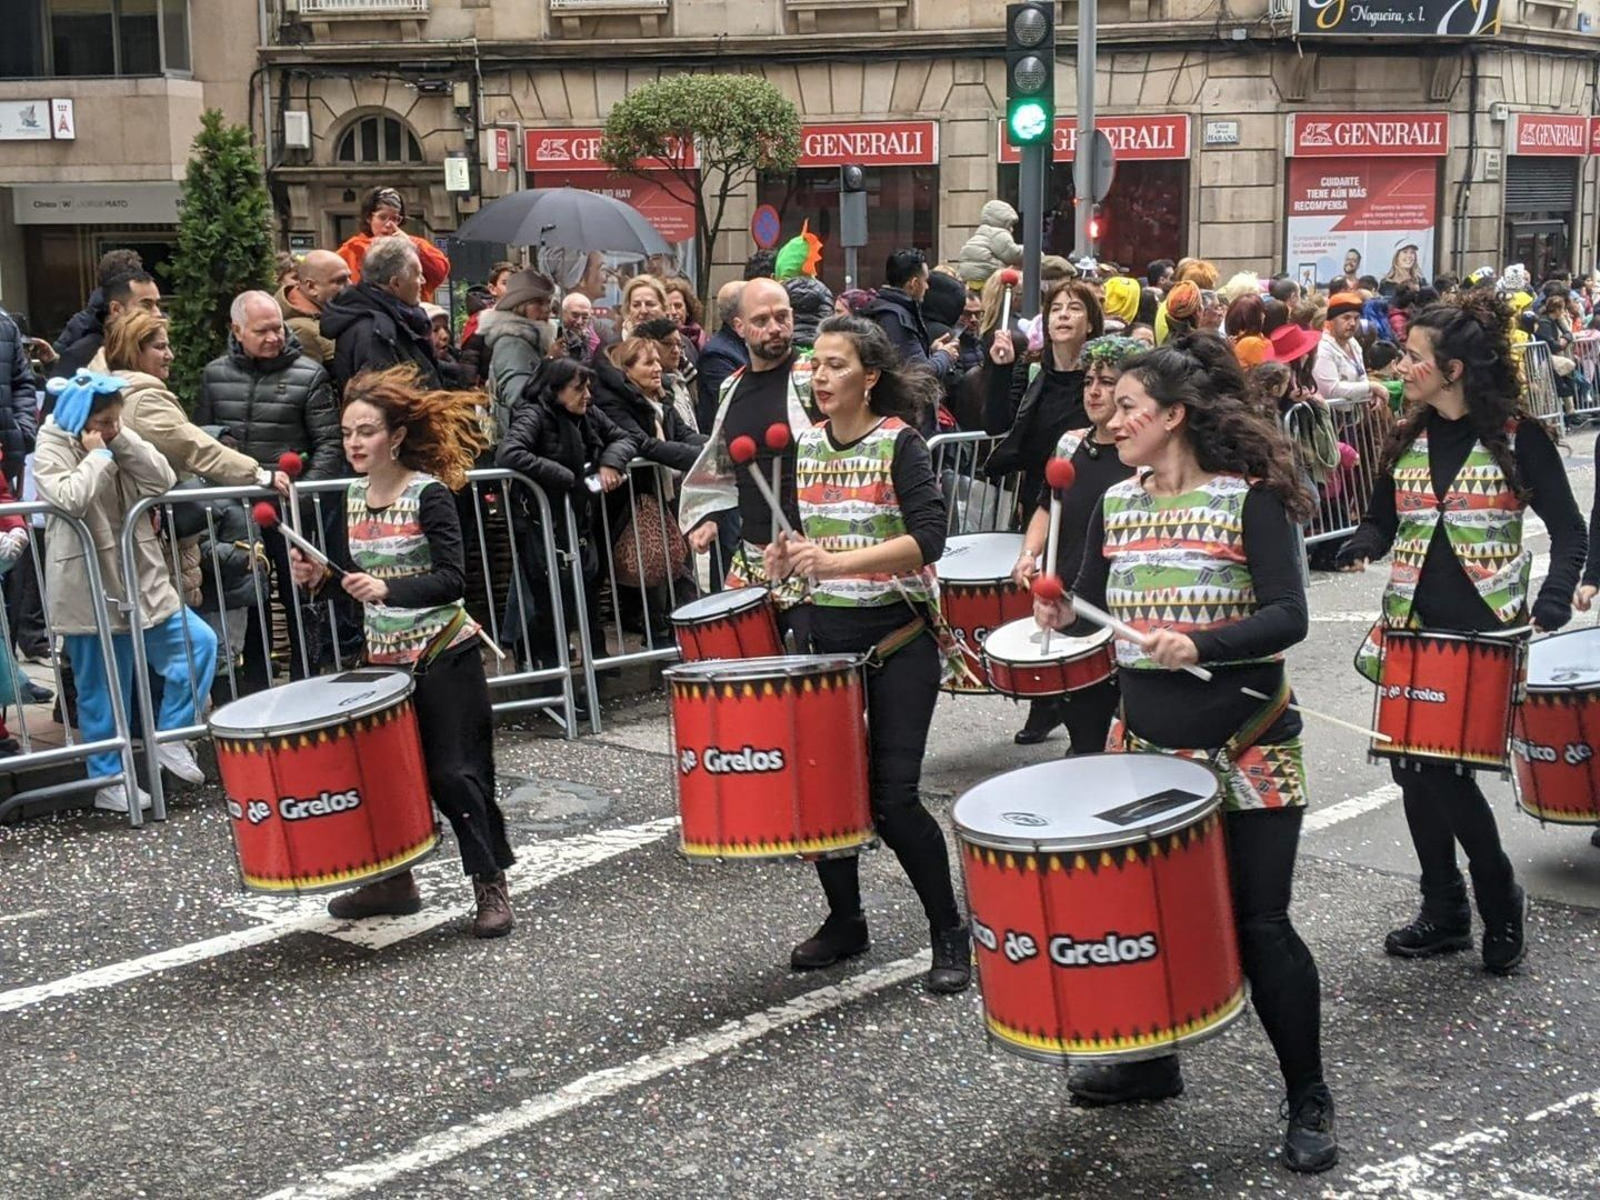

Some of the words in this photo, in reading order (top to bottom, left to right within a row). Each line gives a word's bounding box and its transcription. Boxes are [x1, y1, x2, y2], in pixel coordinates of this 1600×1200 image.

[805, 131, 923, 157] GENERALI
[1053, 124, 1175, 151] GEERALI
[1334, 121, 1442, 146] GENERALI
[1535, 123, 1583, 146] GENERALI
[615, 188, 632, 198] HAY
[1320, 176, 1360, 187] CUIDARTE
[1294, 200, 1348, 211] RECOMPENSA
[1306, 189, 1330, 199] TIENE
[703, 747, 785, 773] Grelos
[1564, 743, 1592, 765] de
[247, 799, 271, 824] de
[279, 790, 360, 820] Grelos
[1004, 932, 1037, 961] de
[1050, 934, 1157, 965] Grelos
